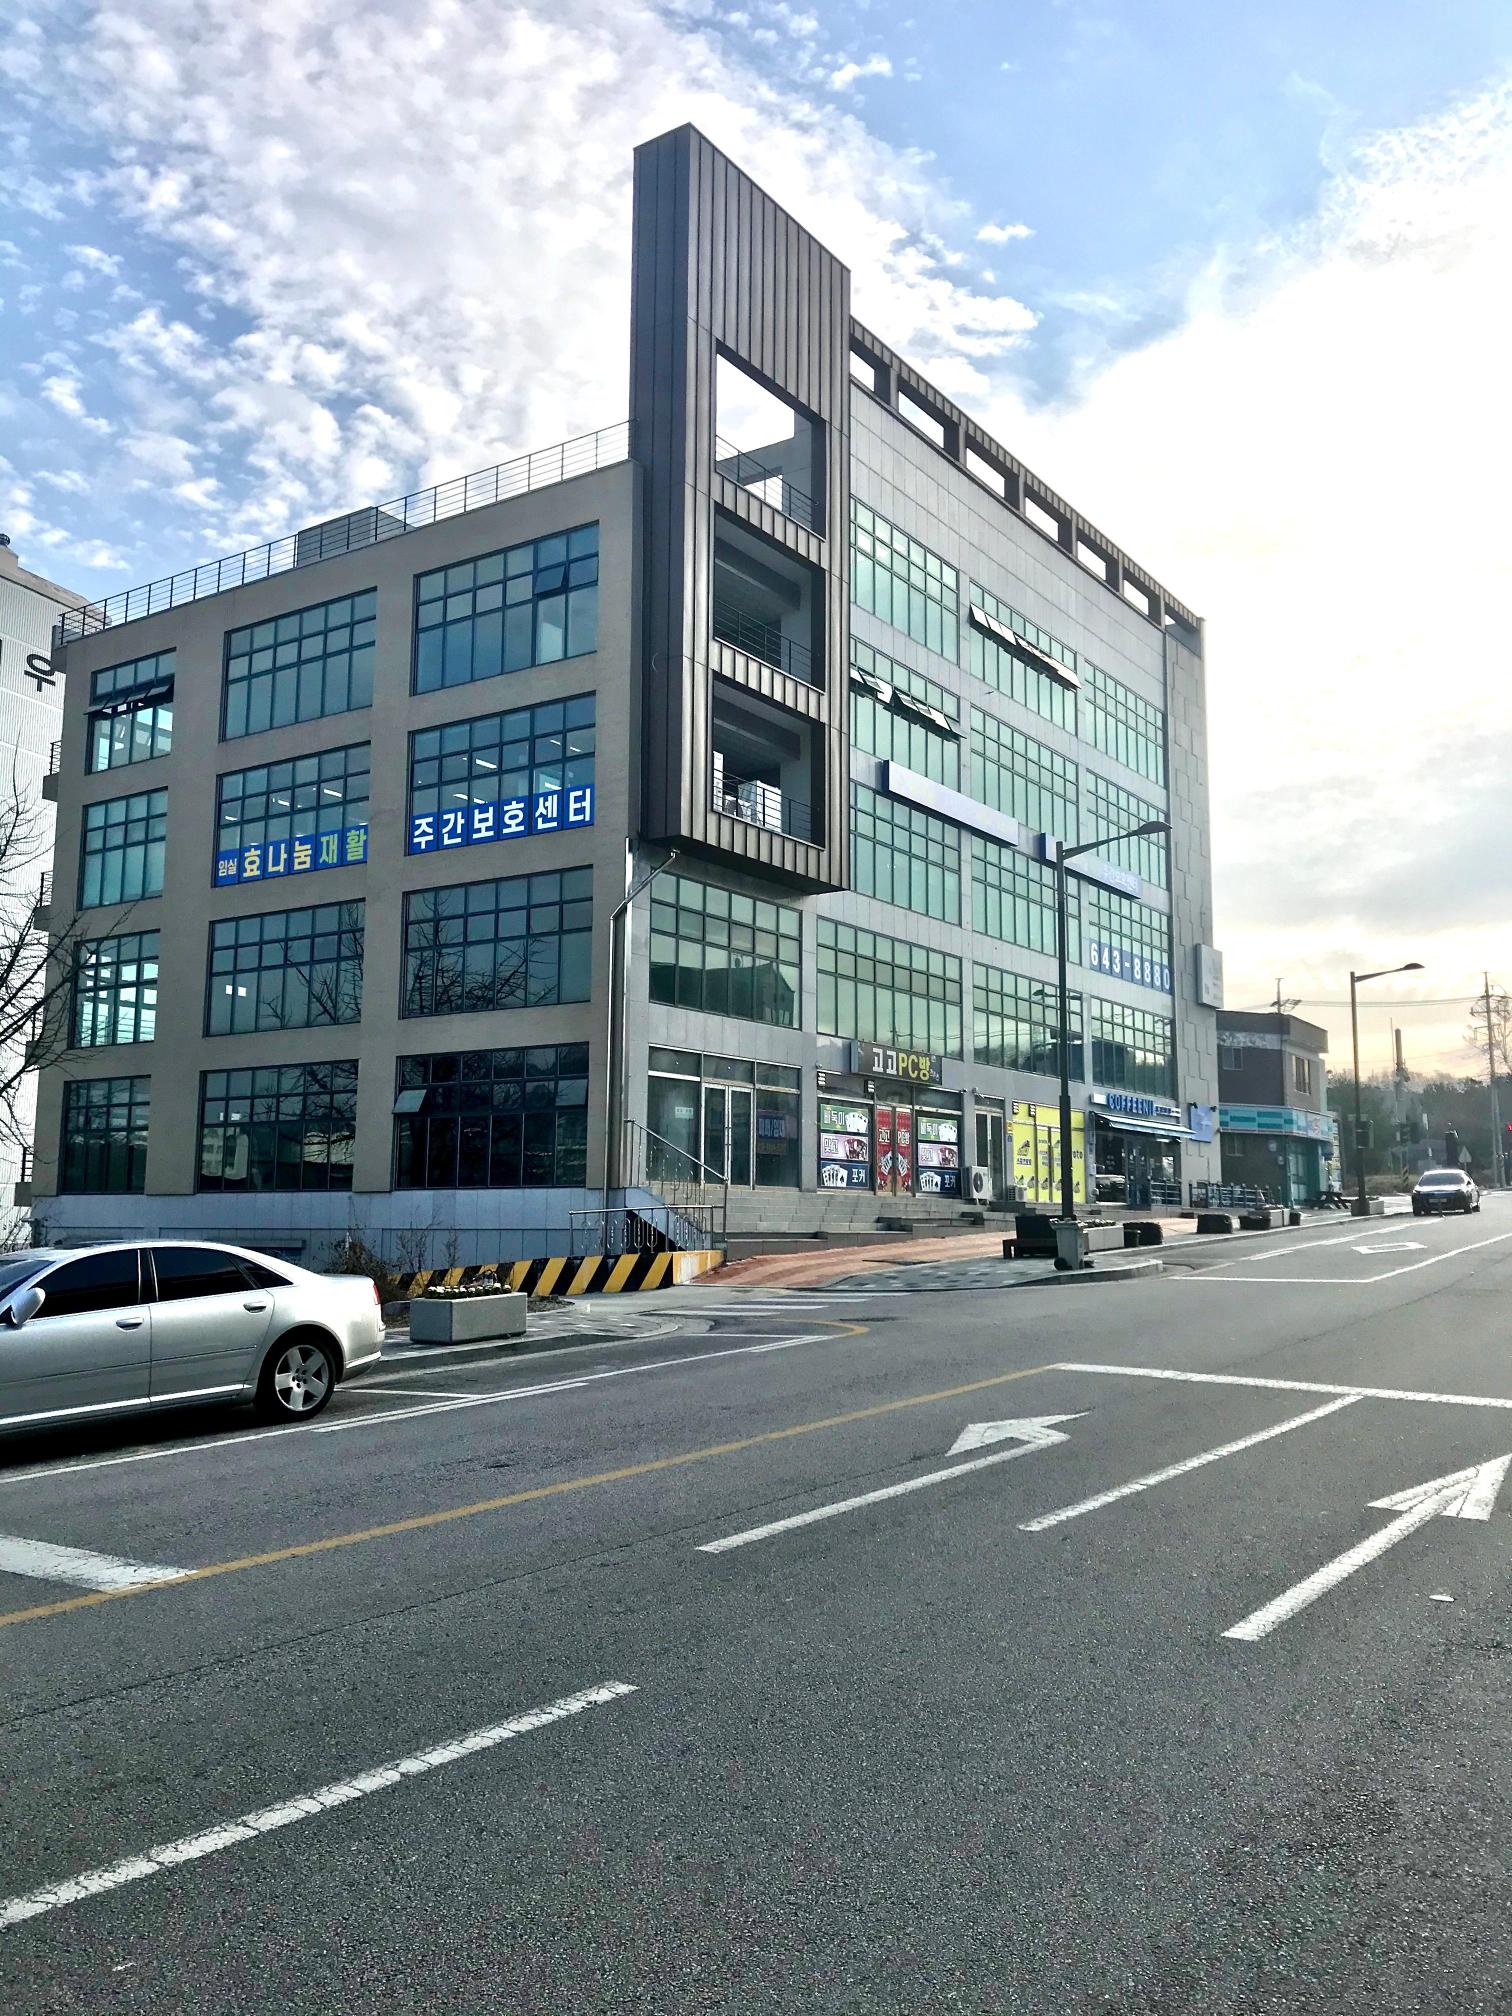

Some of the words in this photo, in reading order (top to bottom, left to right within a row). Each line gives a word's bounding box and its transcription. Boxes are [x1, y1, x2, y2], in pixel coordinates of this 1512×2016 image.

[412, 787, 592, 850] 주간보호센터
[1090, 942, 1170, 990] 643-8880
[1072, 1149, 1083, 1159] oto
